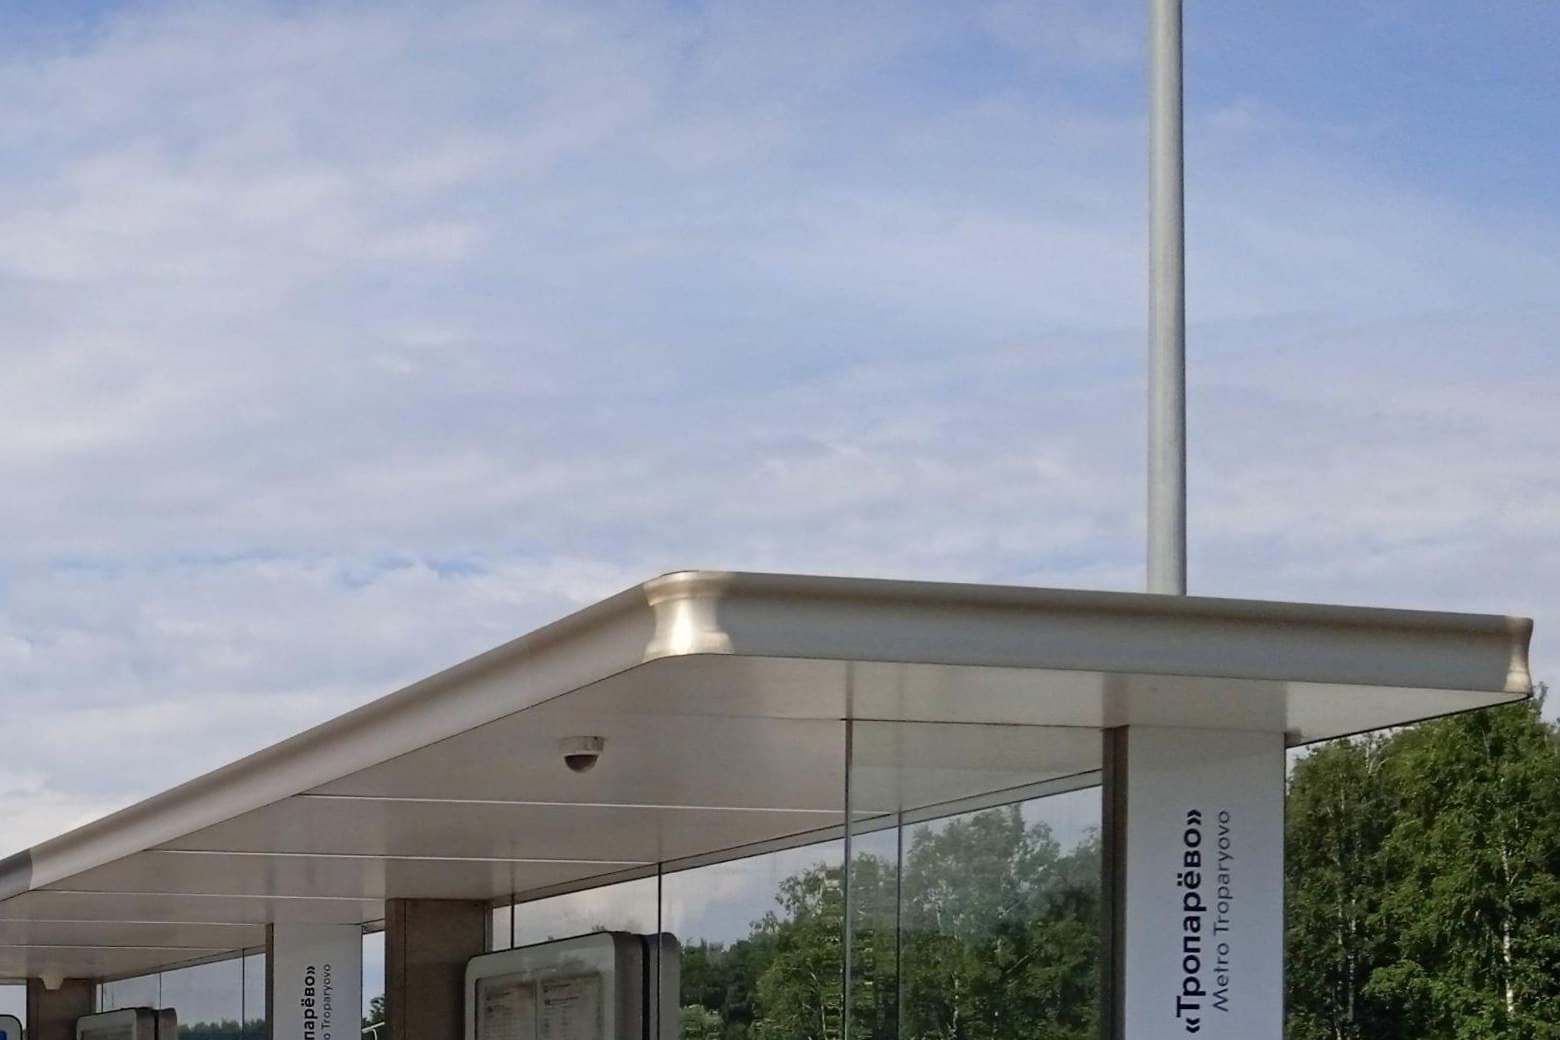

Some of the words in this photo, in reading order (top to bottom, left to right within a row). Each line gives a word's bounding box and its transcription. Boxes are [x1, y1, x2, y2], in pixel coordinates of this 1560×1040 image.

[1176, 809, 1207, 1033] «Тропарёво»
[1213, 810, 1233, 937] Troparyovo
[321, 964, 333, 1030] Troparyovo
[1212, 943, 1230, 1013] Metro
